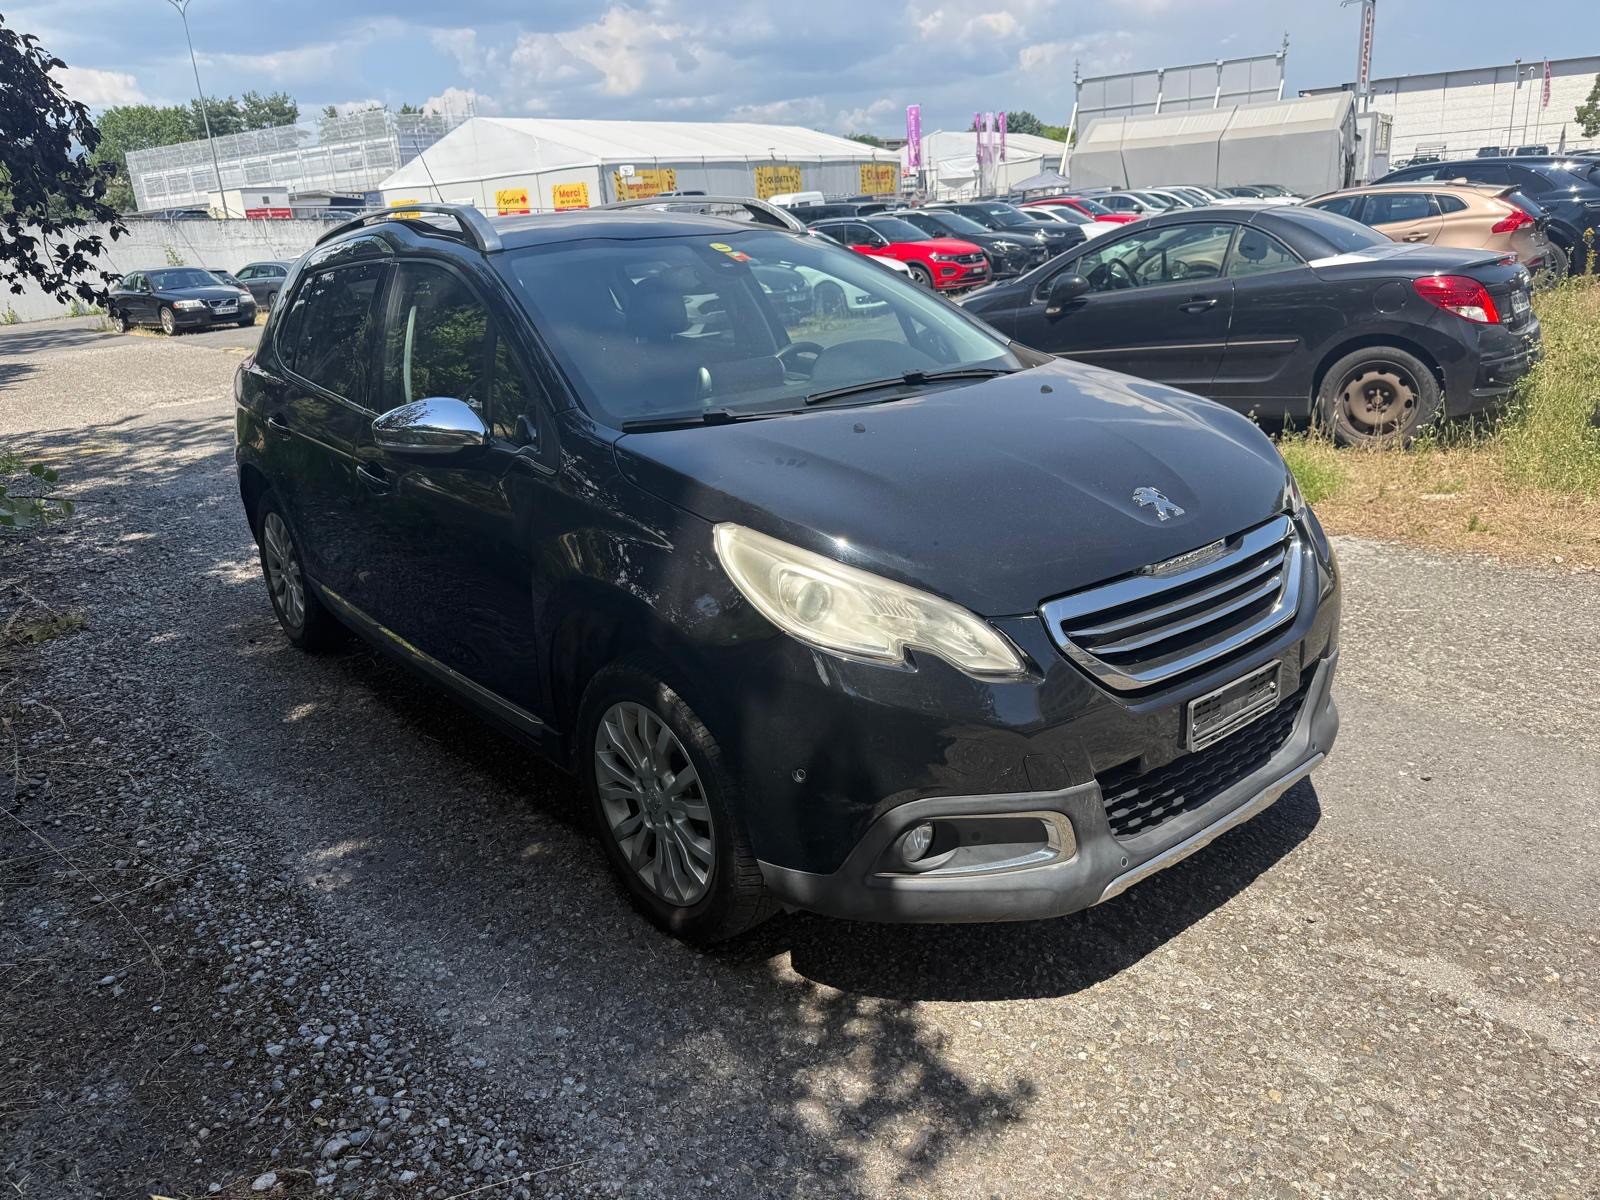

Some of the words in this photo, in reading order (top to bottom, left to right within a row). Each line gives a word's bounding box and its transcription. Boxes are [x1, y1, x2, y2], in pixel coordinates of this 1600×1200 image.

[1361, 7, 1372, 88] JUMBO
[559, 189, 580, 198] Merci
[502, 197, 519, 205] Sortie
